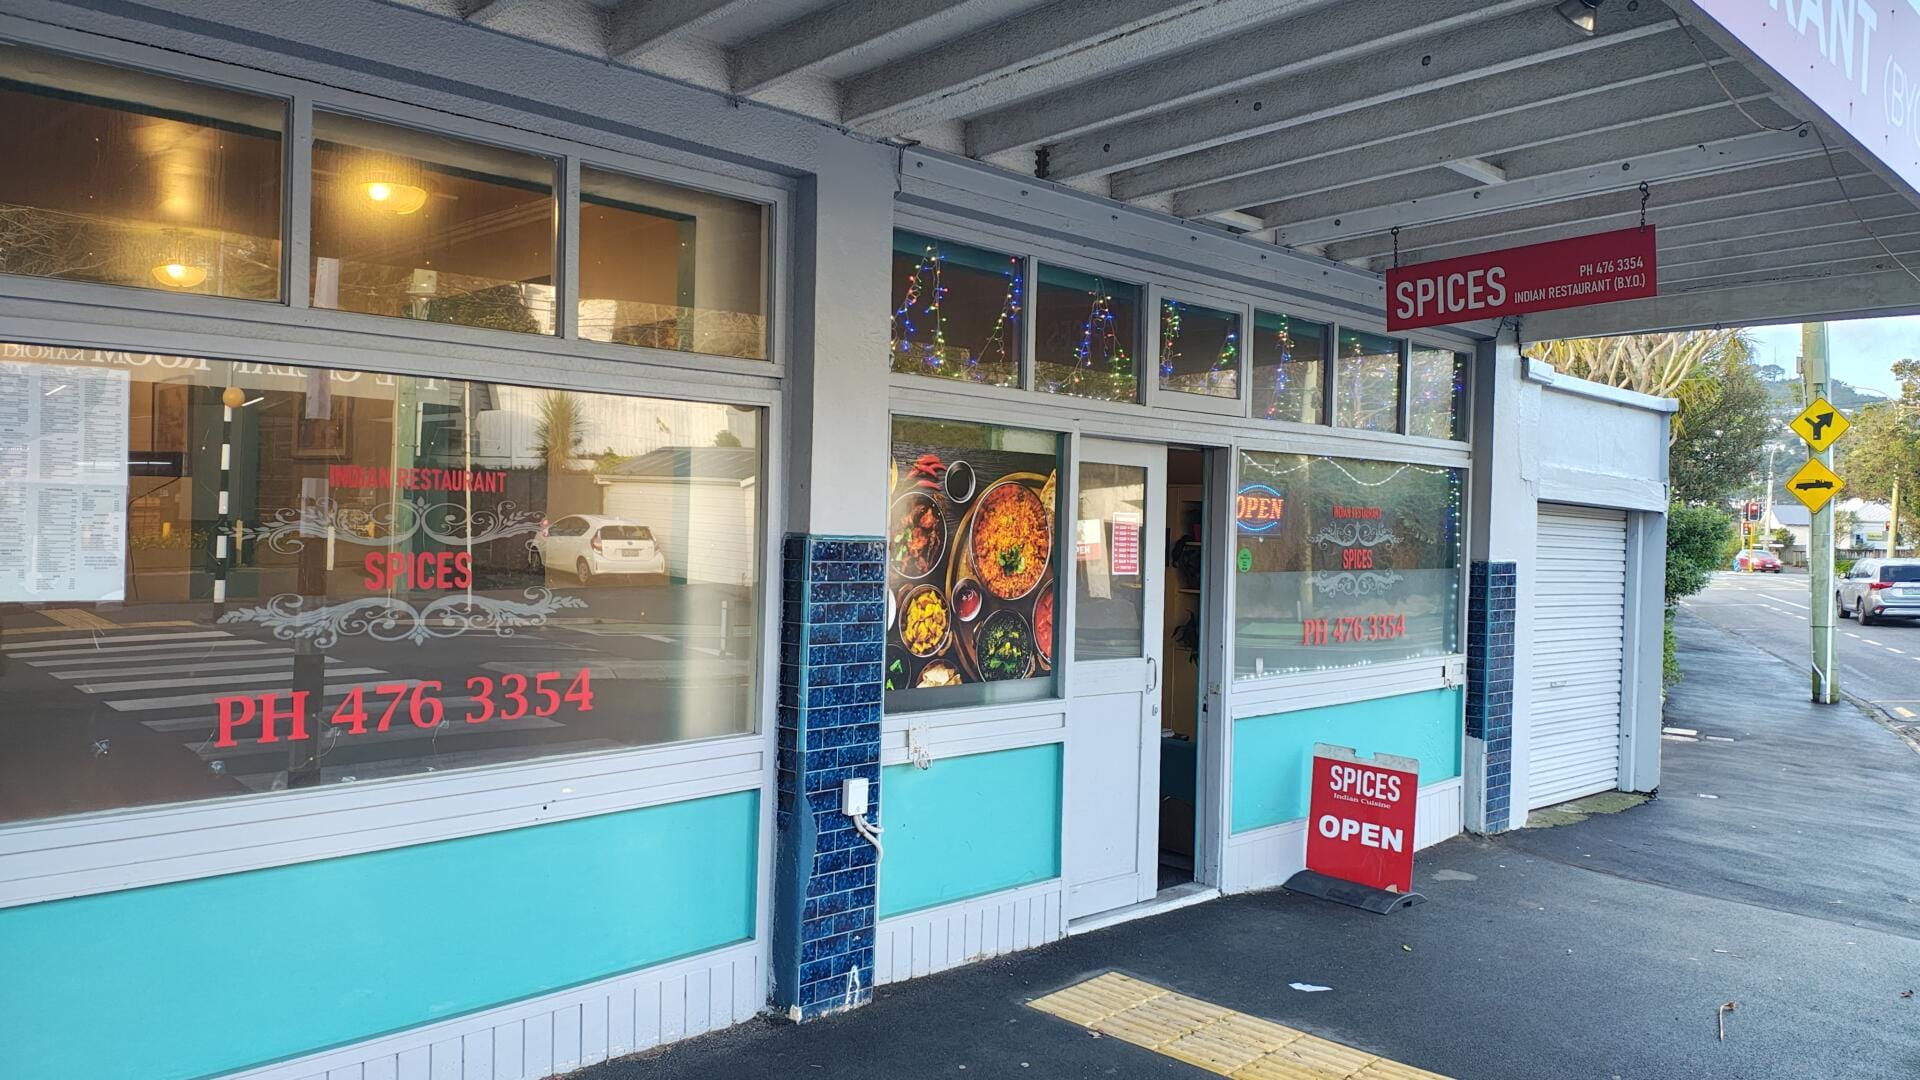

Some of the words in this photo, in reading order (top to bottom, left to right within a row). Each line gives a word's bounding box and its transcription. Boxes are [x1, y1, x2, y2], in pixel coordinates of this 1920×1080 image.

[1580, 264, 1593, 277] PH
[1596, 260, 1614, 274] 476
[1617, 256, 1643, 272] 3354
[1396, 266, 1507, 320] SPICES
[1514, 288, 1546, 303] INDIAN
[1548, 278, 1611, 299] RESTAURANT
[1614, 273, 1646, 292] (B.Y.O.)
[329, 464, 391, 488] INDIAN
[395, 467, 507, 493] RESTAURANT
[1237, 496, 1284, 519] OPEN
[363, 551, 473, 591] SPICES
[1343, 549, 1373, 569] SPICES
[1303, 618, 1328, 646] PH
[1333, 616, 1363, 643] 476
[1368, 613, 1406, 641] 3354
[213, 690, 311, 748] PH
[331, 679, 444, 735] 476
[466, 667, 594, 724] 3354
[1329, 765, 1401, 802] SPICES
[1333, 792, 1359, 803] Indian
[1361, 797, 1391, 809] Cuisine
[1318, 814, 1404, 853] OPEN
